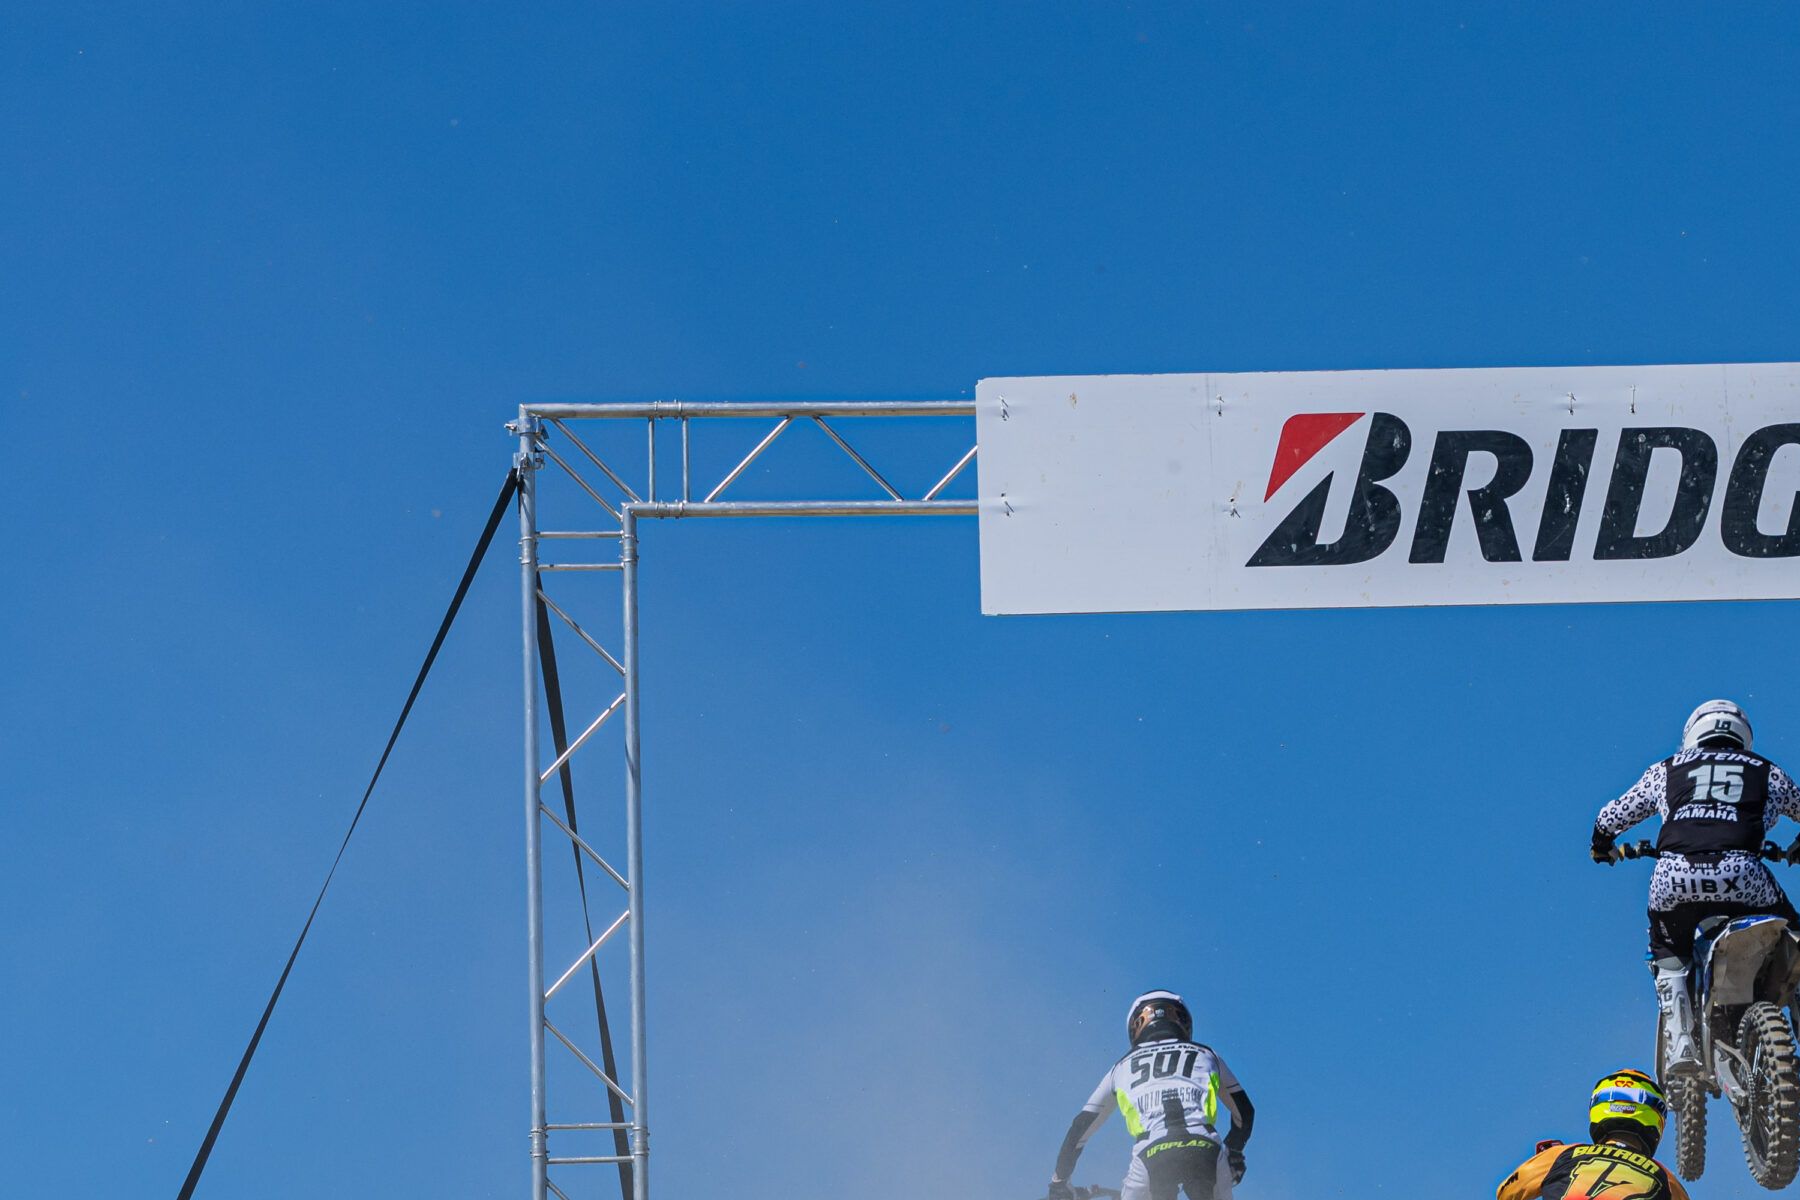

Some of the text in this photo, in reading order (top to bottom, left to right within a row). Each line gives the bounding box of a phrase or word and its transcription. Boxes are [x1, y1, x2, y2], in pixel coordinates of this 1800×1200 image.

[1672, 752, 1764, 767] OUTEIRO
[1687, 764, 1745, 804] 15
[1673, 807, 1738, 822] YAMAHA
[1130, 1049, 1199, 1090] 501
